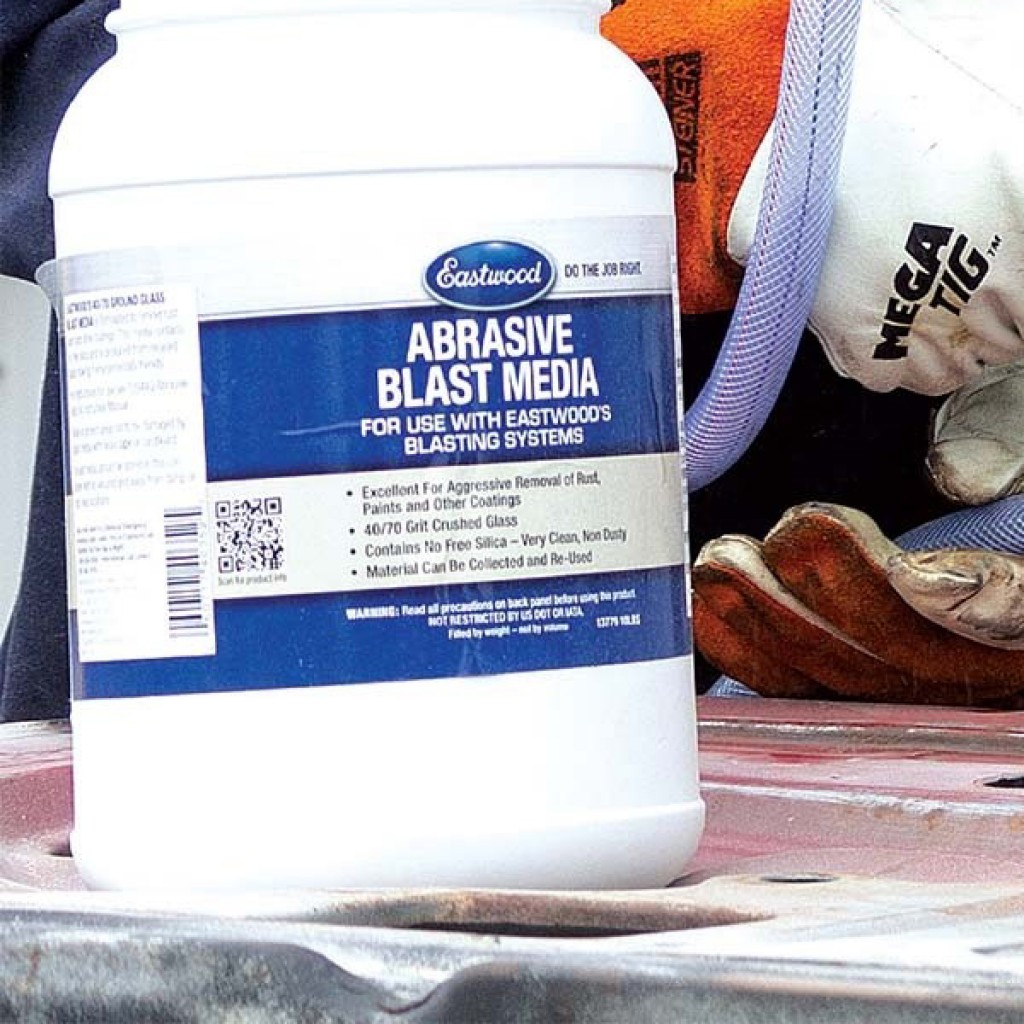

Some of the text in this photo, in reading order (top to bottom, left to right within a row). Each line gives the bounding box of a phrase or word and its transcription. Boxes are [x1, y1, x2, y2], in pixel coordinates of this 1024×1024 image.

[436, 257, 542, 289] Eastwood
[564, 264, 579, 278] DO
[581, 262, 600, 276] THE
[601, 261, 618, 276] JOB
[872, 222, 954, 360] MEGA
[406, 313, 574, 363] ABRASIVE
[376, 357, 600, 409] BLAST MEDIA
[361, 404, 612, 437] FOR USE WITH EASTWOOD'S
[404, 427, 584, 455] BLASTING SYSTEMS
[362, 483, 419, 499] Excellent
[422, 481, 442, 495] For
[446, 478, 512, 495] Aggressive
[514, 474, 561, 489] Removal
[563, 473, 574, 486] of
[363, 492, 522, 516] Paints and Other Coatings
[364, 514, 518, 537] 40/70 Grit Crushed Glass
[365, 542, 421, 558] Contains
[424, 540, 442, 554] No
[445, 538, 472, 553] Free
[475, 535, 508, 550] Silica
[521, 533, 547, 549] Very
[582, 528, 601, 543] Non
[603, 527, 627, 542] Dusty
[366, 550, 593, 578] Material Can Be Collected and Re-Used
[345, 605, 400, 620] WARNING:
[401, 603, 426, 616] Read
[427, 602, 440, 615] all
[440, 599, 494, 616] precautions
[506, 597, 530, 609] back
[530, 594, 552, 608] panel
[427, 615, 448, 627] NOT
[448, 610, 506, 626] RESTRICTED
[507, 610, 519, 622] BY
